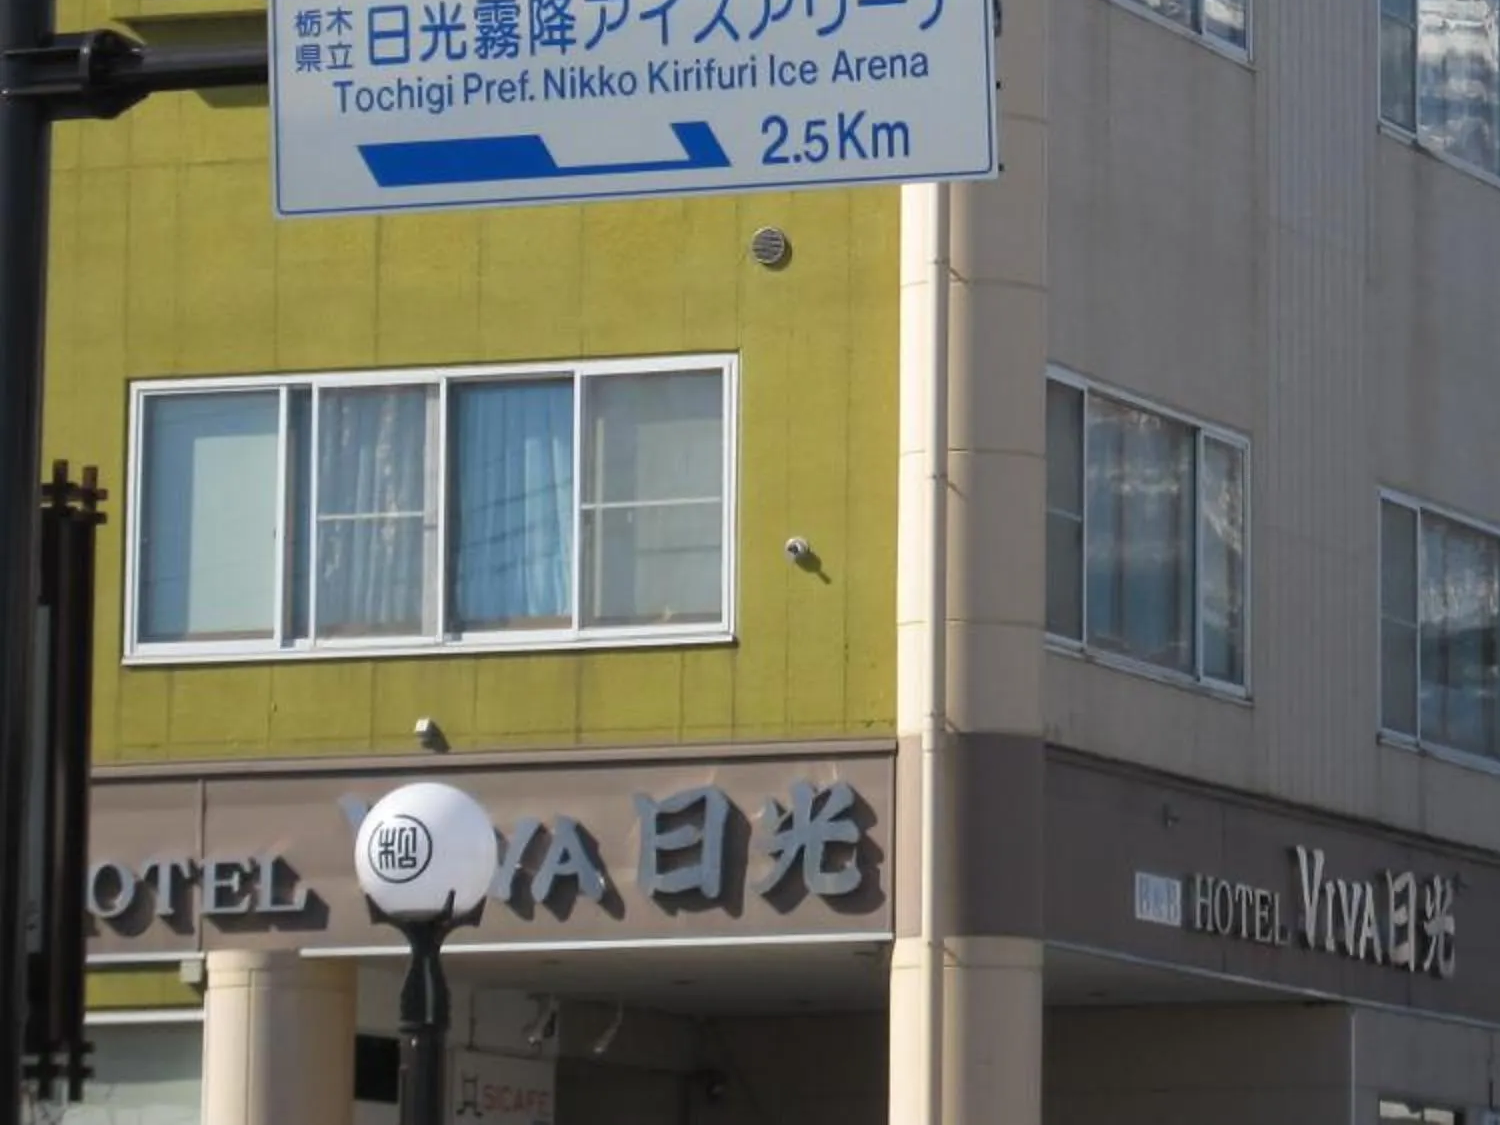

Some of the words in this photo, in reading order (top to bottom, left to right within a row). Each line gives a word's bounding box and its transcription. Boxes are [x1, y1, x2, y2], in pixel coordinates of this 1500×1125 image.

[333, 76, 455, 114] Tochigi
[463, 68, 536, 105] Pref.
[543, 64, 638, 100] Nikko
[648, 54, 764, 95] Kirifuri
[768, 53, 819, 87] Ice
[830, 50, 930, 83] Arena
[760, 109, 912, 166] 2.5Km
[87, 853, 309, 918] OTEL
[1194, 873, 1291, 946] HOTEL
